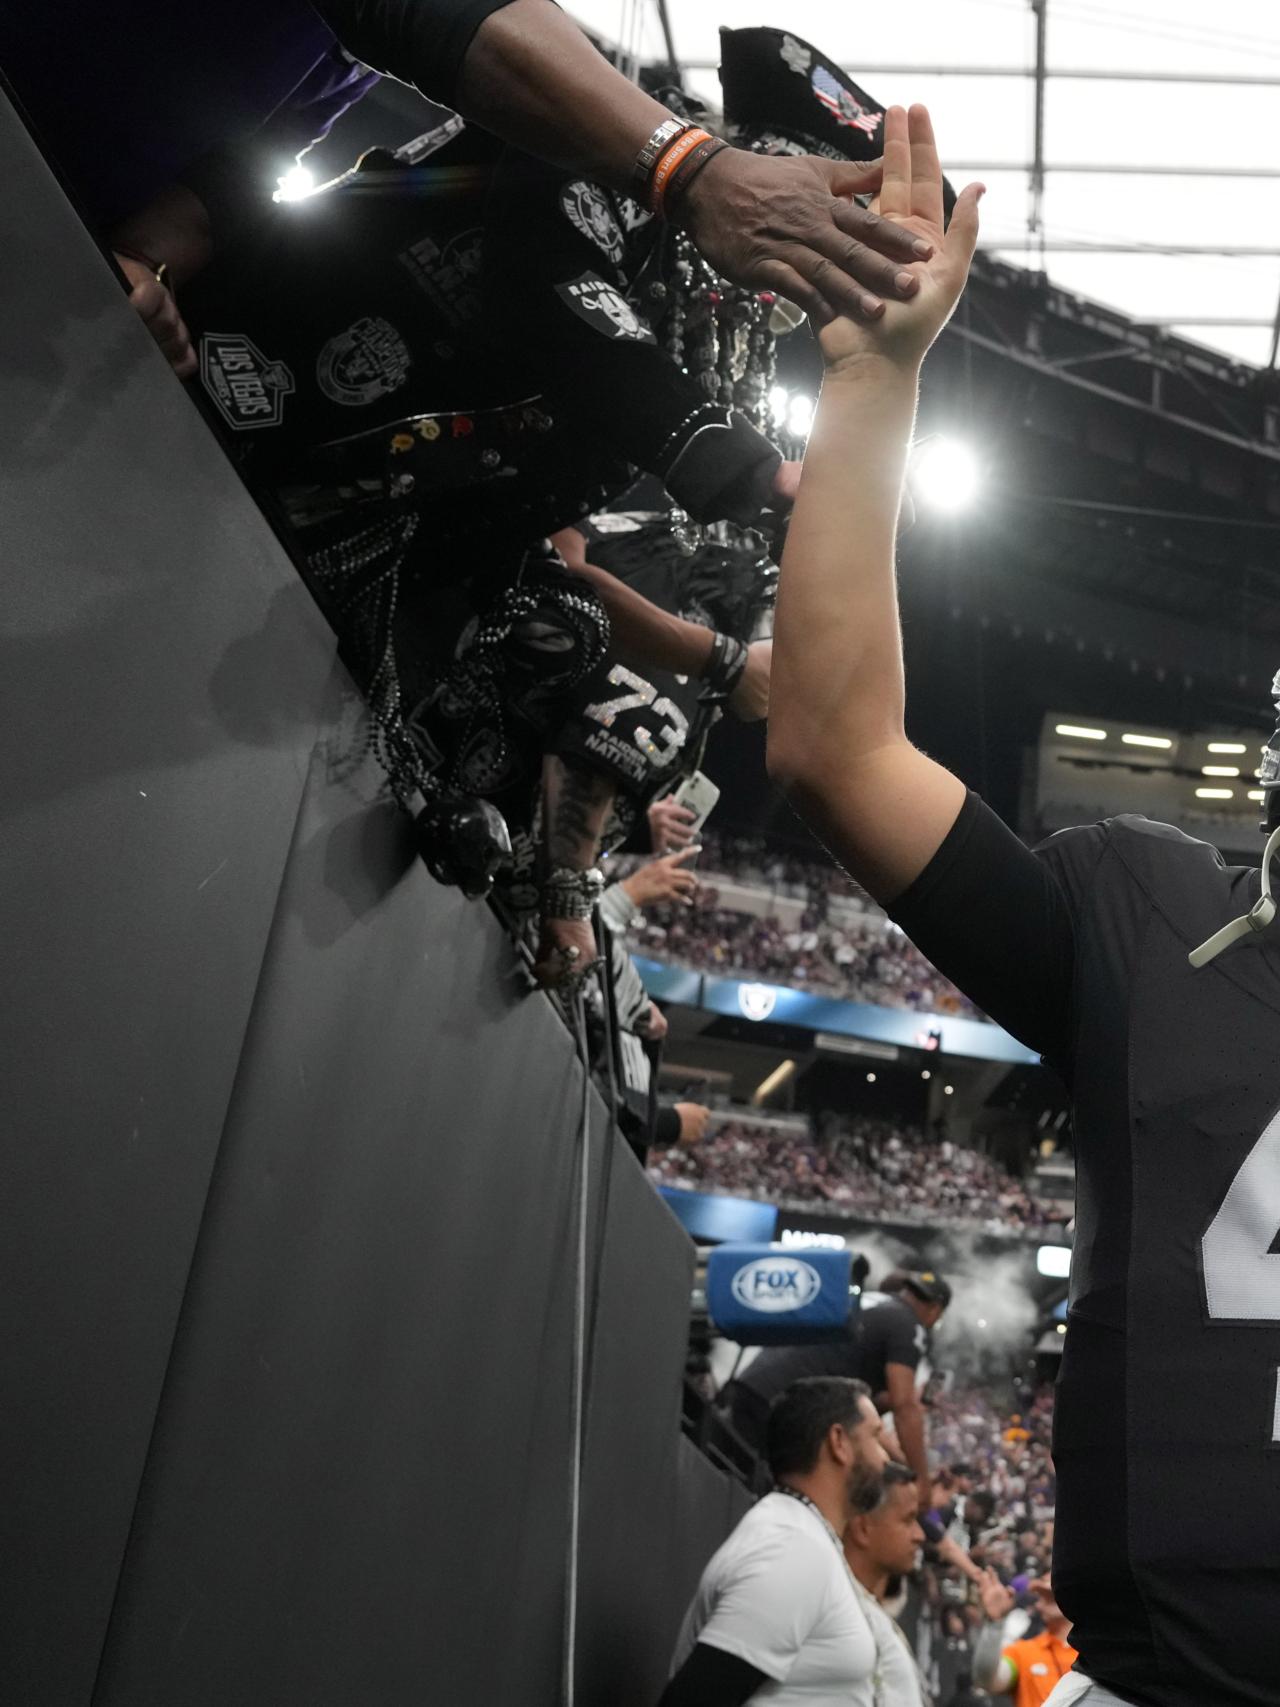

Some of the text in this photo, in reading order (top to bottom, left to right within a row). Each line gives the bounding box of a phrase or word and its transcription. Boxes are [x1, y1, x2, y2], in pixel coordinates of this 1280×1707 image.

[662, 146, 683, 170] Smart
[217, 346, 255, 372] LAS
[227, 372, 273, 415] VEGAS
[583, 663, 689, 766] 73
[599, 729, 647, 766] RAIDER
[754, 1270, 799, 1289] FOX
